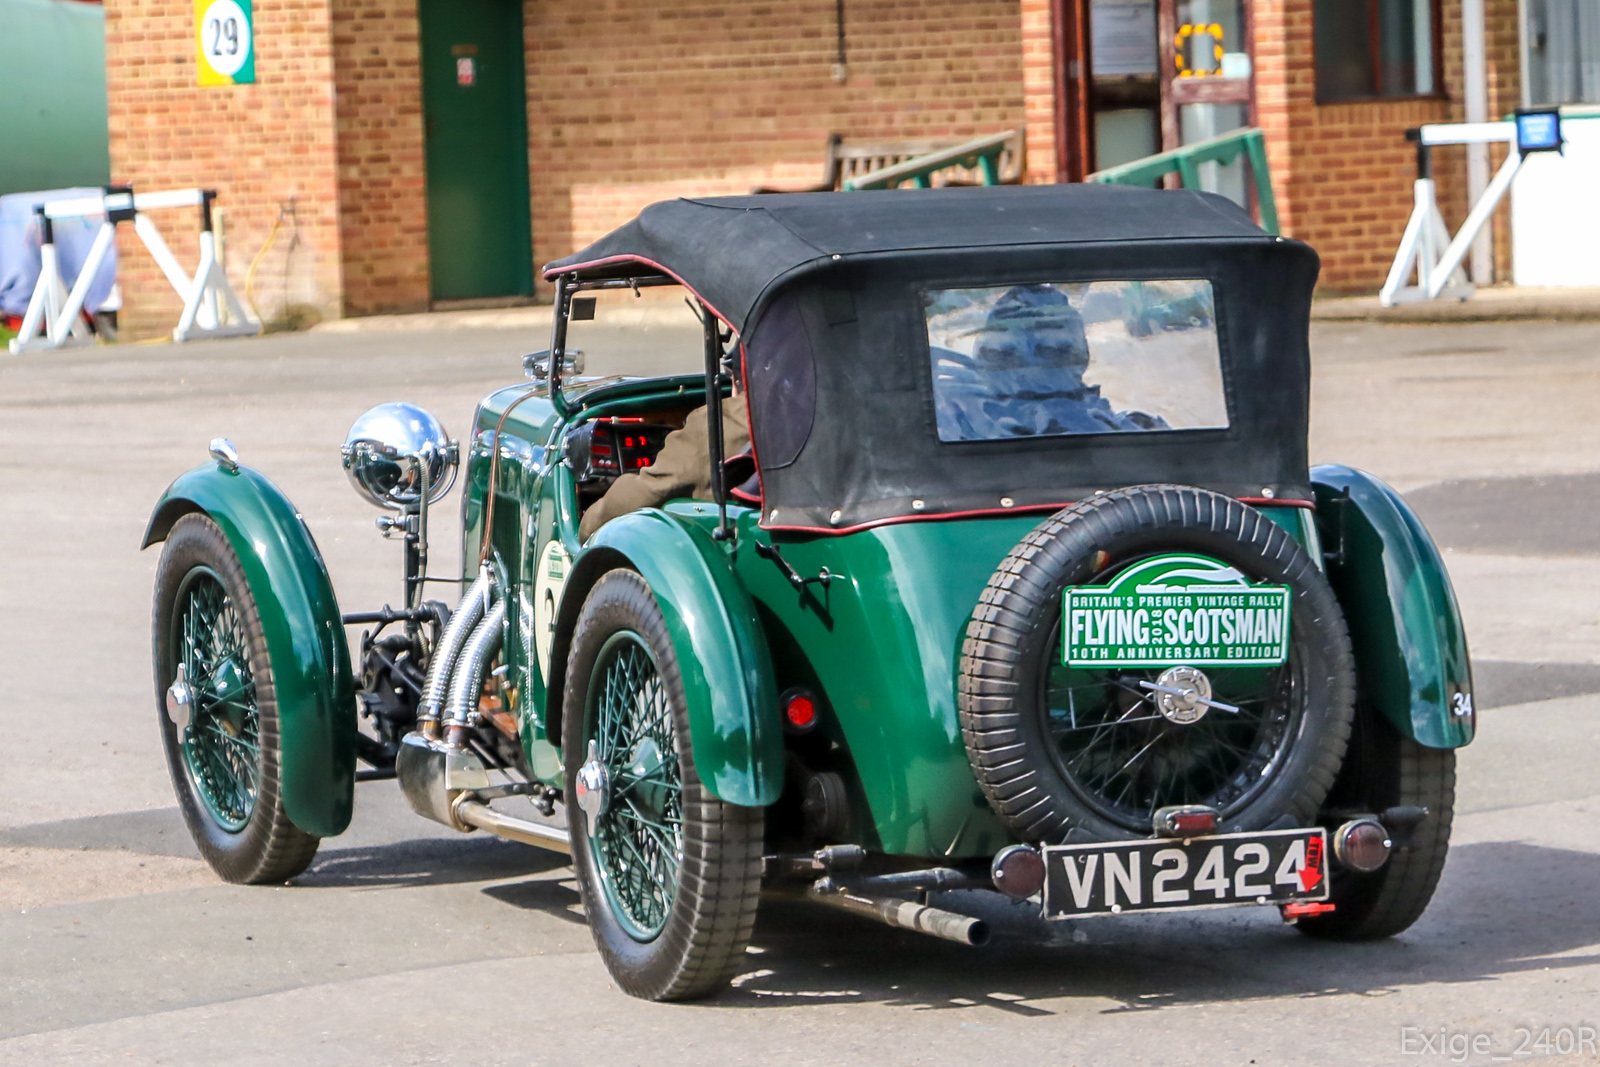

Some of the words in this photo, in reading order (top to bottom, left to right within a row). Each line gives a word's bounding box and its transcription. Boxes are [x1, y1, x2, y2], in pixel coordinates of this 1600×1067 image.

[210, 17, 238, 55] 29
[1072, 596, 1134, 607] BRITAIN'S
[1139, 596, 1192, 607] PREMIER
[1196, 596, 1245, 607] VINTAGE
[1249, 596, 1283, 607] RALLY
[1071, 608, 1150, 646] FLYING
[1163, 608, 1282, 646] SCOTSMAN
[1151, 609, 1163, 645] 2018
[1072, 647, 1109, 659] 10TH
[1117, 647, 1220, 659] ANNIVERSARY
[1227, 646, 1281, 658] EDITION
[1453, 692, 1472, 716] 34
[1308, 843, 1319, 868] TOW
